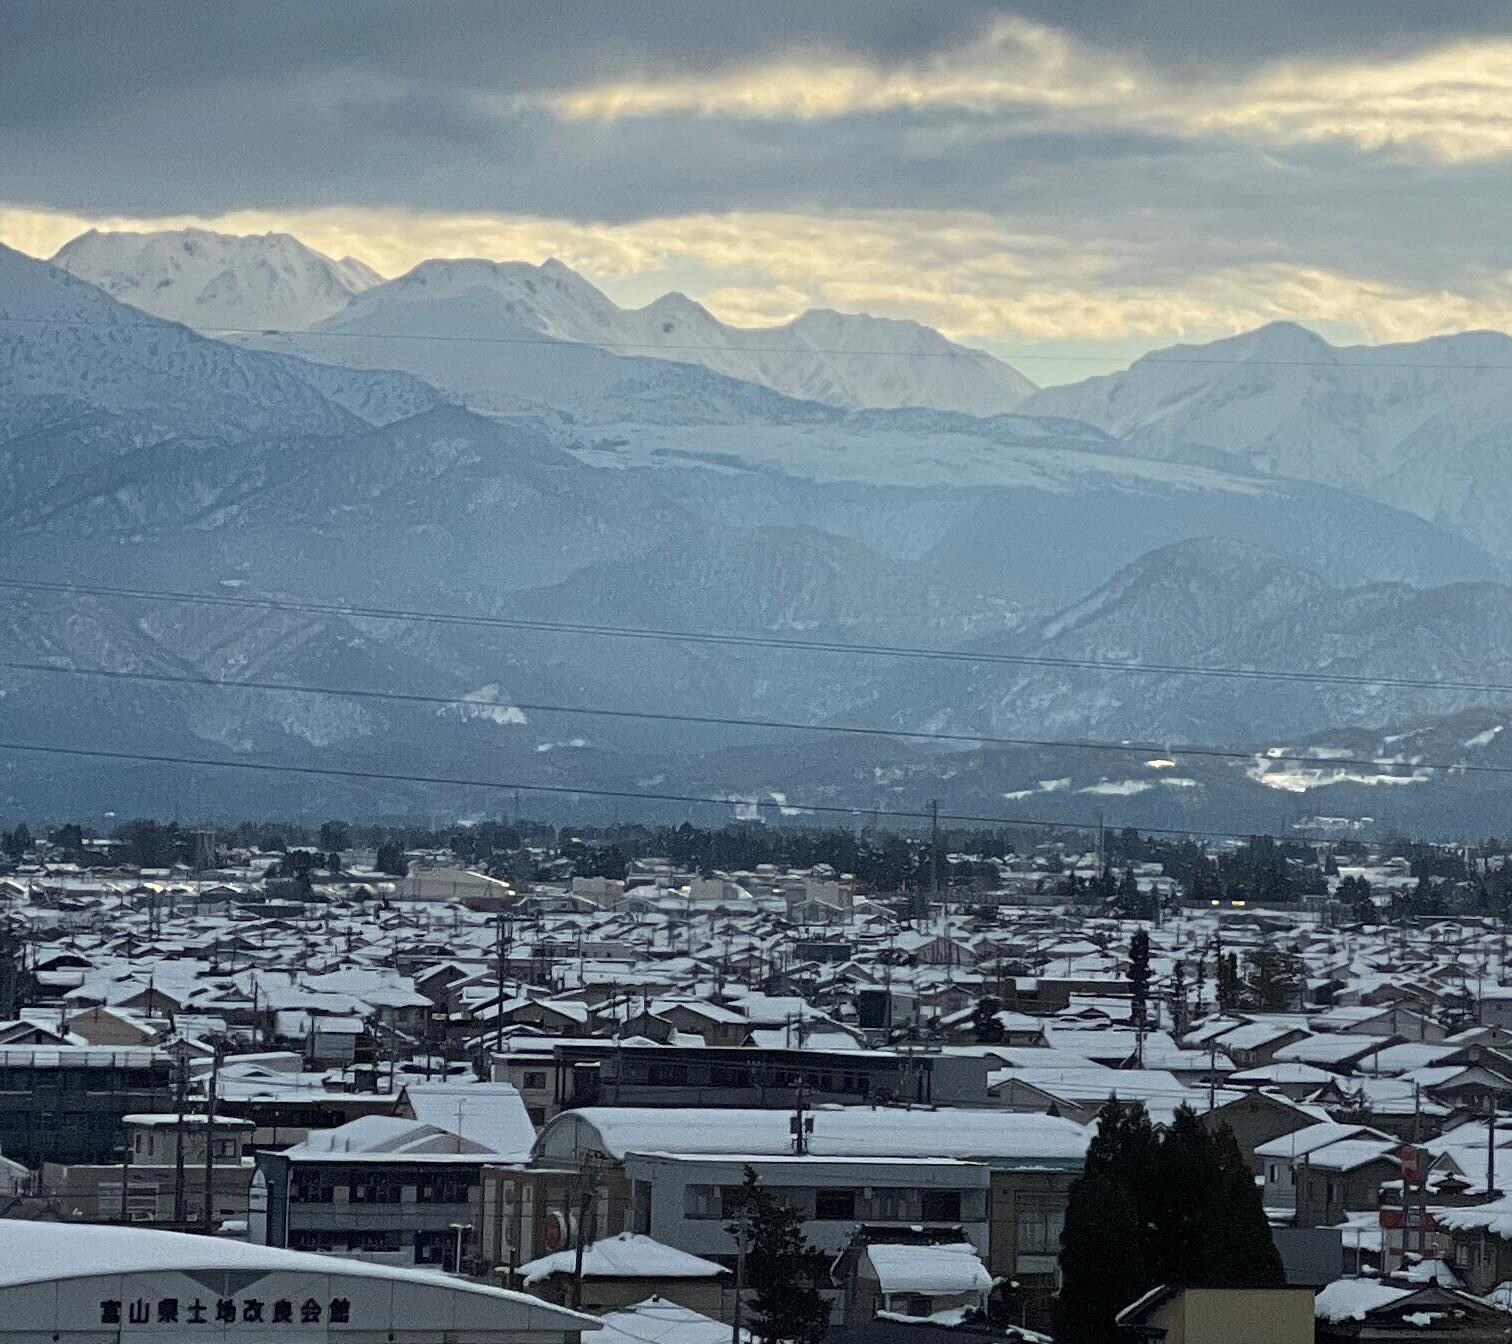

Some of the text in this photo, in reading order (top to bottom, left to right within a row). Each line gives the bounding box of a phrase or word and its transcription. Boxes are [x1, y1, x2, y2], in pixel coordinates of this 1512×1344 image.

[100, 1297, 351, 1324] 富山県土地改良会館
